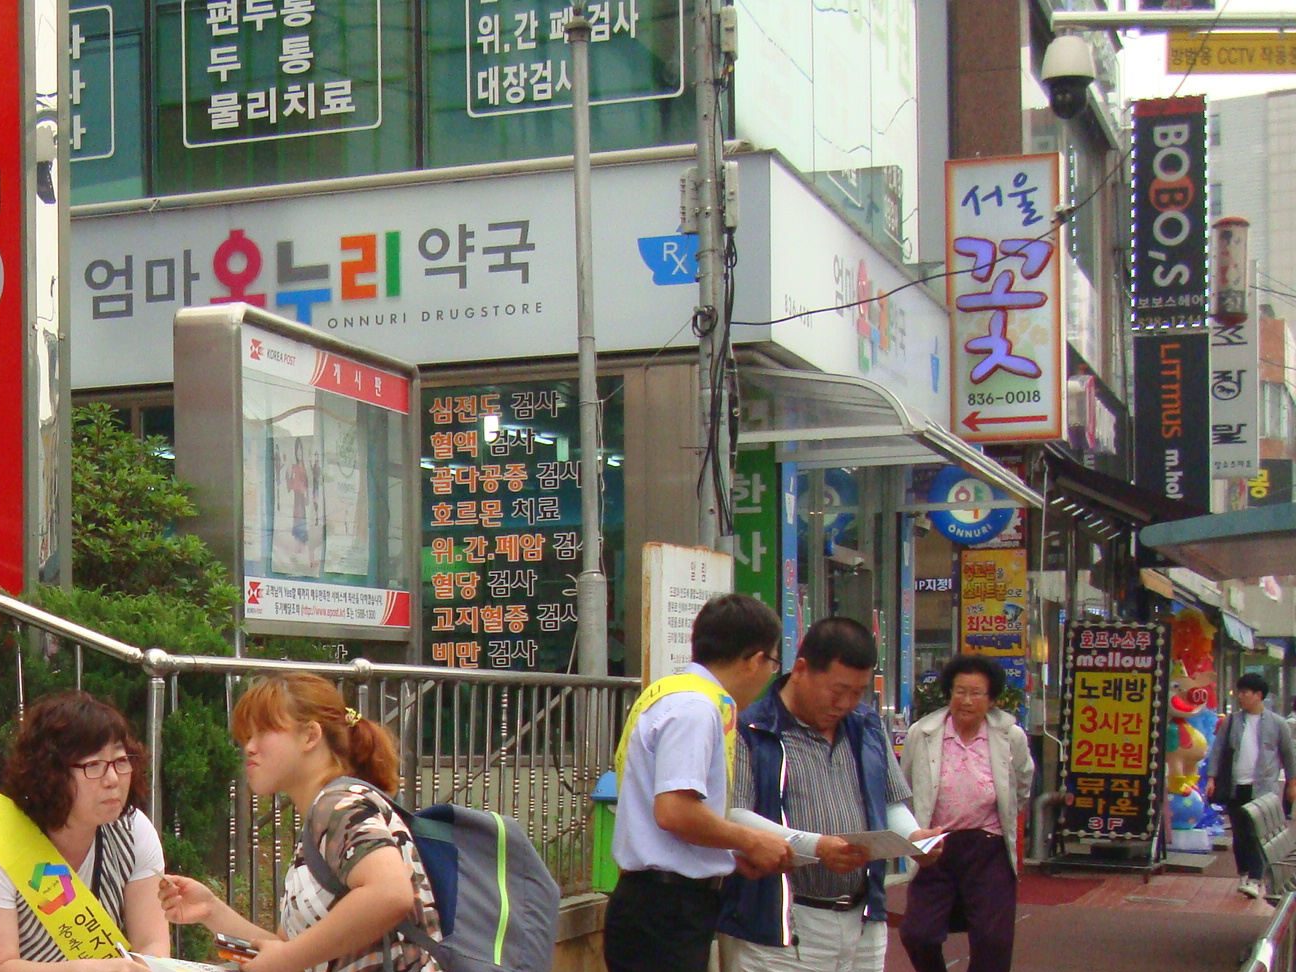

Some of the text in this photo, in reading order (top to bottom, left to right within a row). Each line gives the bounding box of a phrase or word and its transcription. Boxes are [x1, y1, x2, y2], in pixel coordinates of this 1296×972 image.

[1216, 47, 1254, 65] CCTV
[208, 80, 355, 130] 물리치료
[962, 172, 1044, 226] 서울
[1148, 124, 1195, 287] BOBO'S
[327, 302, 543, 329] ONNURI DRUGSTORE
[953, 236, 1053, 384] 꽃
[267, 349, 296, 366] KOREA POST
[429, 391, 560, 424] 심전도 검사
[967, 389, 1041, 406] 836-0018
[430, 428, 535, 459] 혈액 검사
[430, 463, 527, 494] 골다공증
[431, 497, 560, 527] 호르몬 치료
[948, 523, 992, 538] ONNURI
[431, 570, 537, 600] 혈당 검사
[431, 605, 528, 634] 고지혈증
[432, 640, 538, 669] 비만 검사
[1080, 631, 1151, 650] 호프+소주
[1076, 652, 1152, 668] mellow
[1078, 678, 1147, 702] 노래방
[1080, 706, 1143, 735] 3시간
[1075, 740, 1143, 769] 2만원
